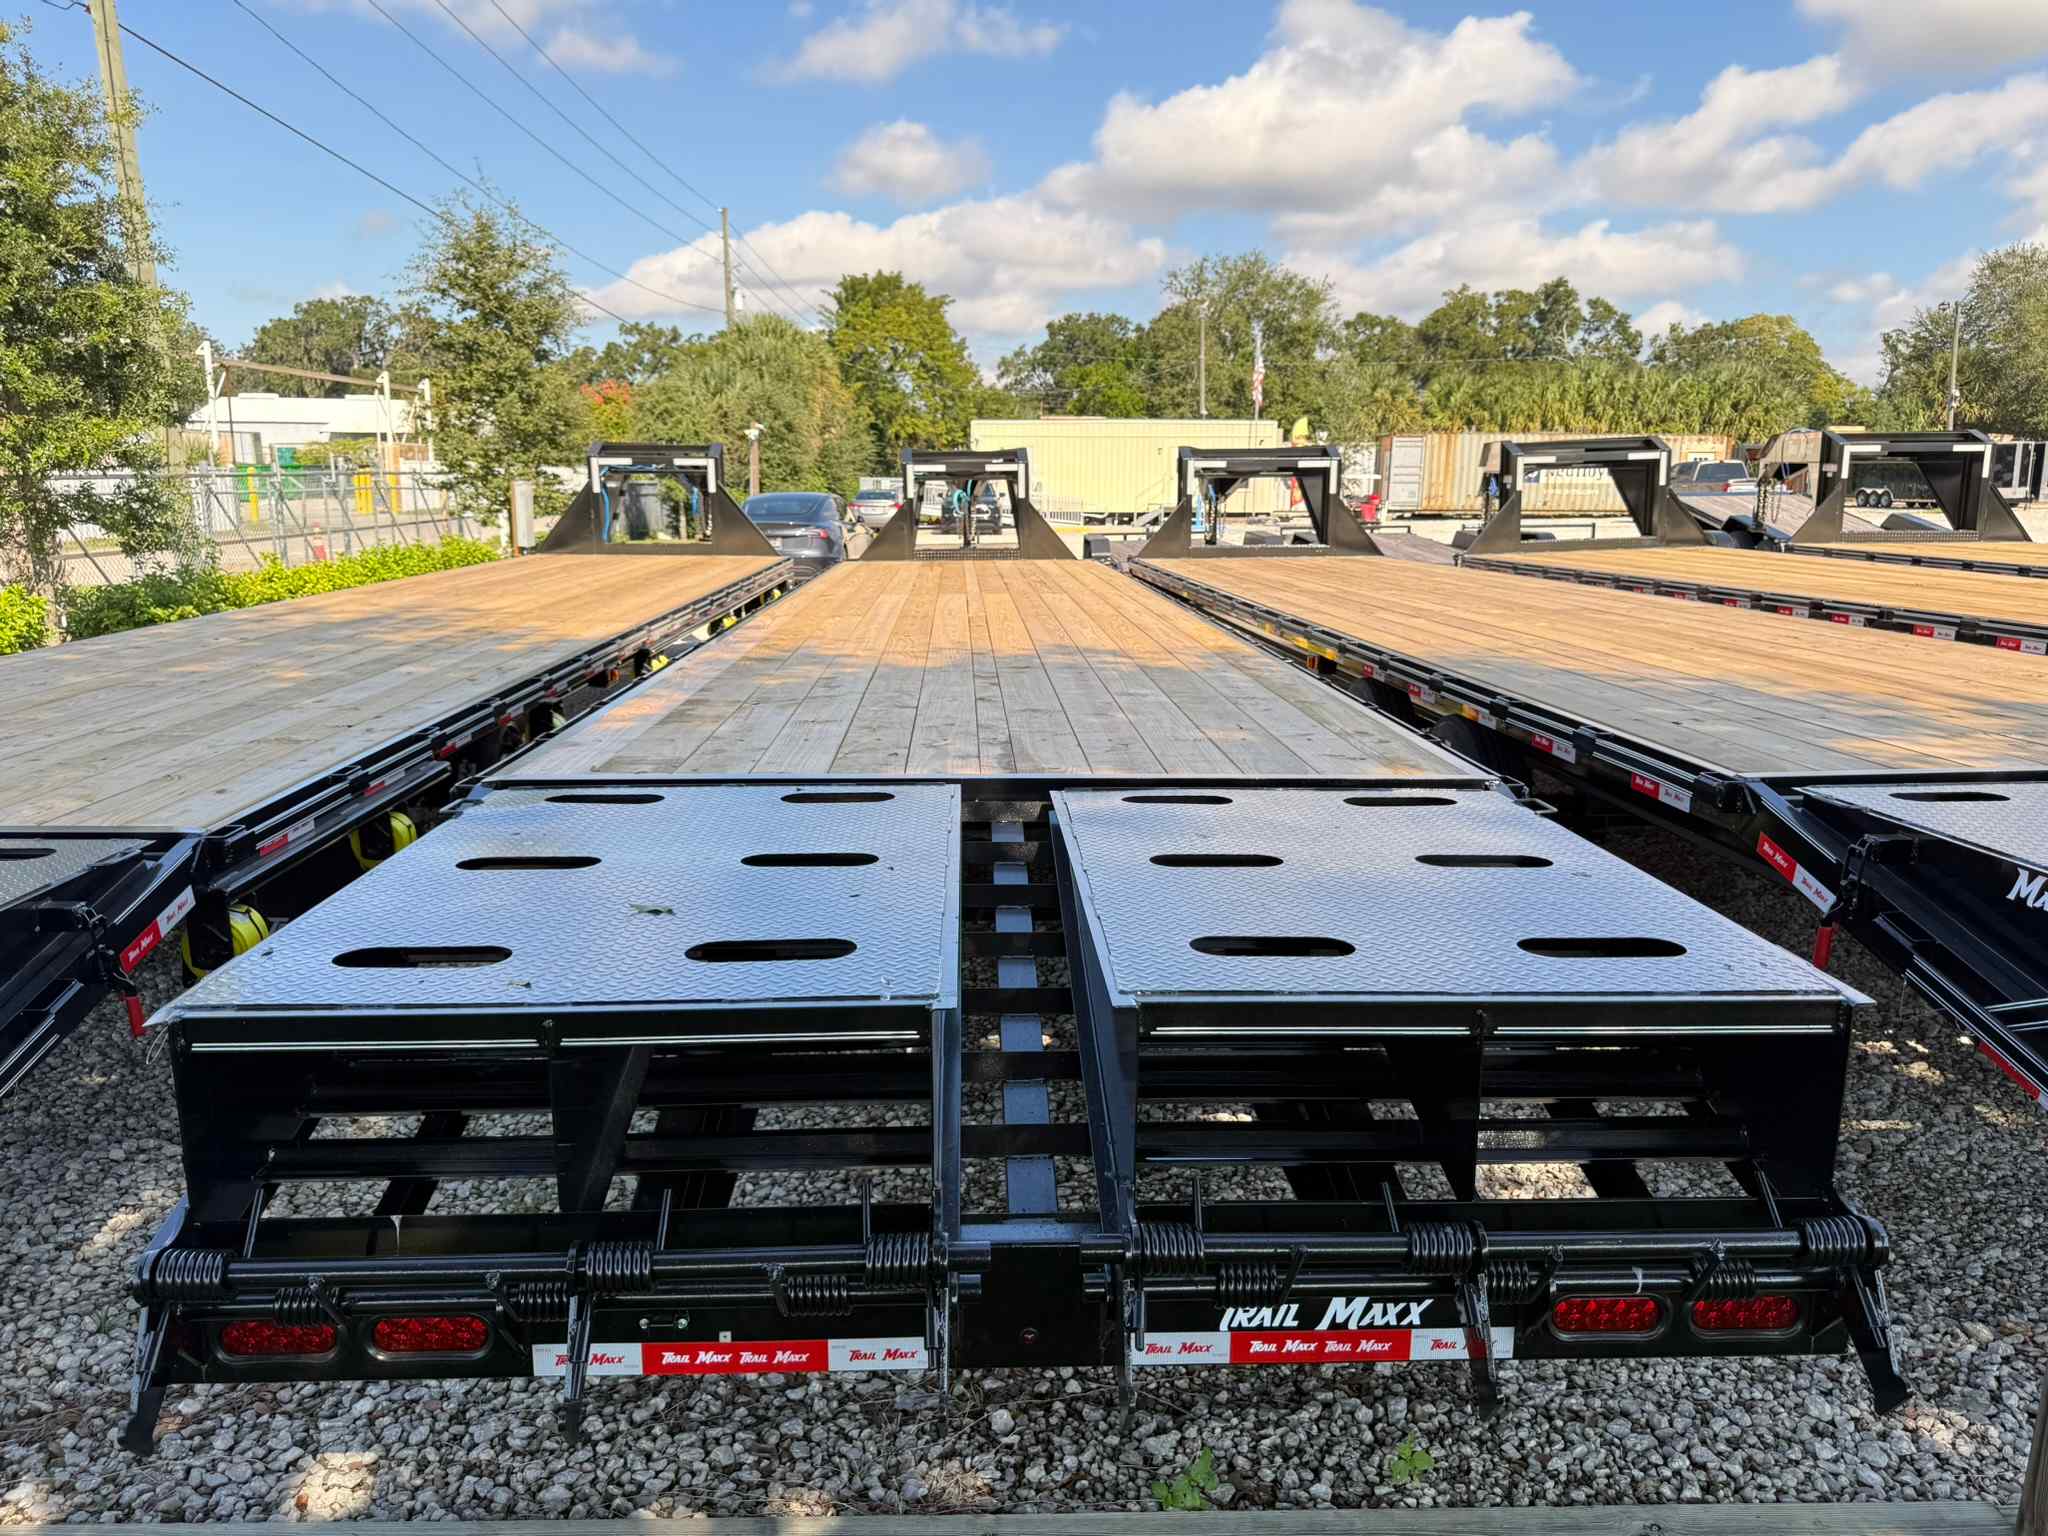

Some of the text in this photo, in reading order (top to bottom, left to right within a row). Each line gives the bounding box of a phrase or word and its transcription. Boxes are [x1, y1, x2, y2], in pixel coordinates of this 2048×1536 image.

[1314, 1297, 1434, 1330] MAXX
[1250, 1339, 1392, 1353] TRAIL MAXX TRAIL MAXX
[661, 1350, 809, 1364] TRAIL MAXX TRAIL MAXX
